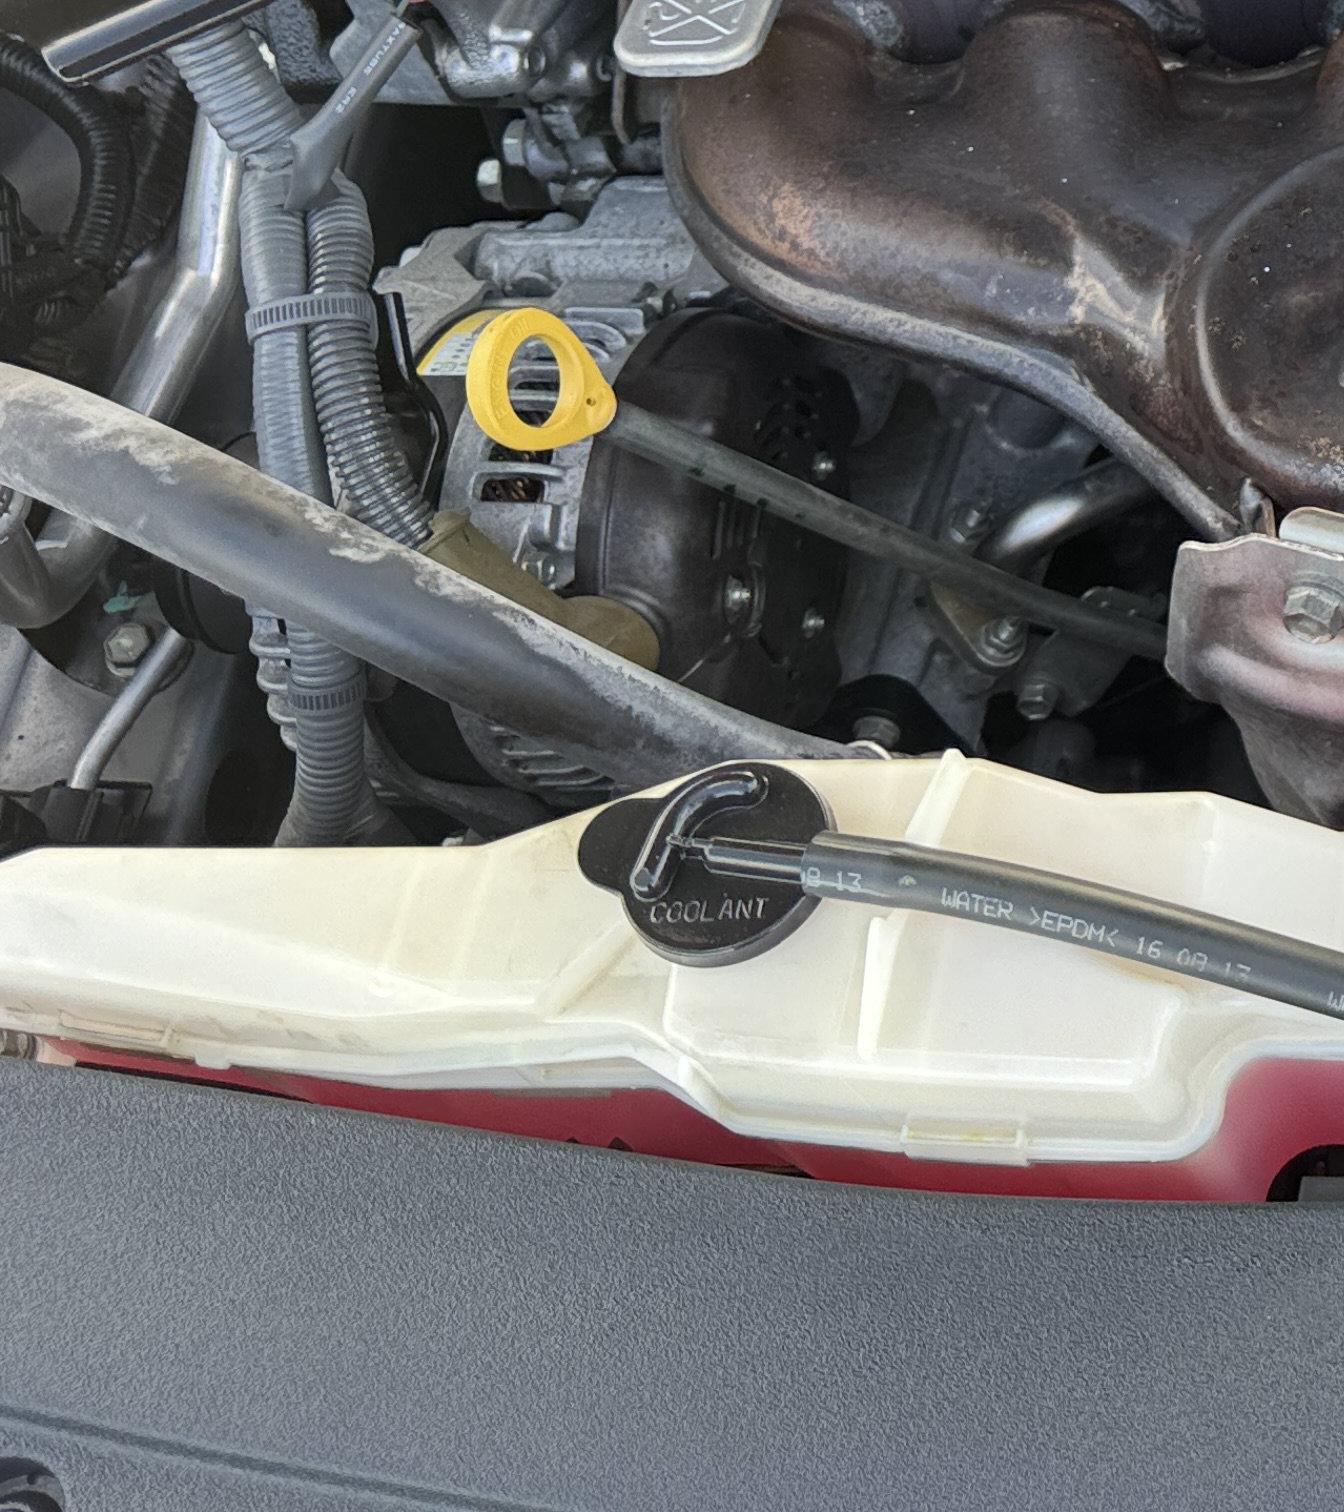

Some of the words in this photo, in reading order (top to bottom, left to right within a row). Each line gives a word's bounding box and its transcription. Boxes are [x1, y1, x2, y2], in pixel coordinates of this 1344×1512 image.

[648, 897, 771, 924] COOLANT
[940, 886, 1015, 921] WATER
[1028, 906, 1119, 948] >EPDM<
[1135, 935, 1162, 959] 16
